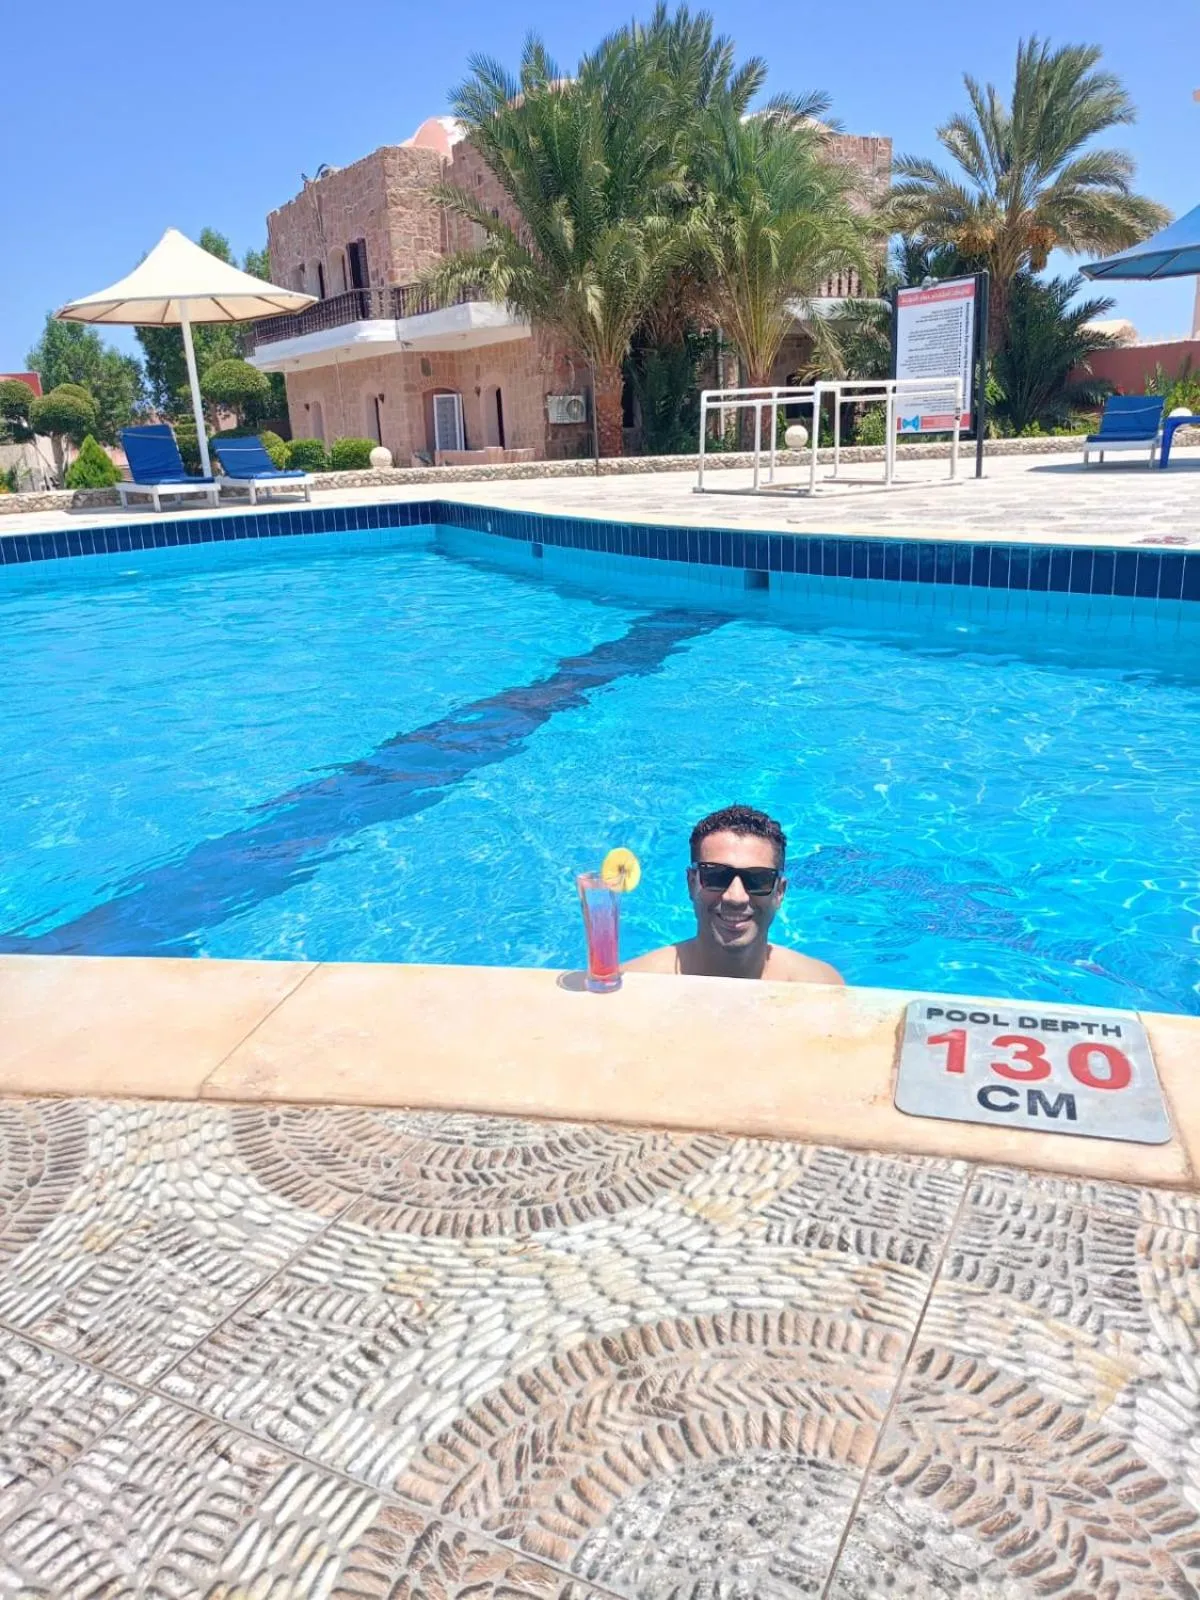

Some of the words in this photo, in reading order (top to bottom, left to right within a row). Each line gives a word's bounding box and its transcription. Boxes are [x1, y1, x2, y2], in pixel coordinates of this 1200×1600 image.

[926, 1007, 1009, 1027] POOL
[1018, 1016, 1122, 1038] DEPTH
[926, 1028, 1133, 1090] 130
[977, 1084, 1078, 1121] CM
